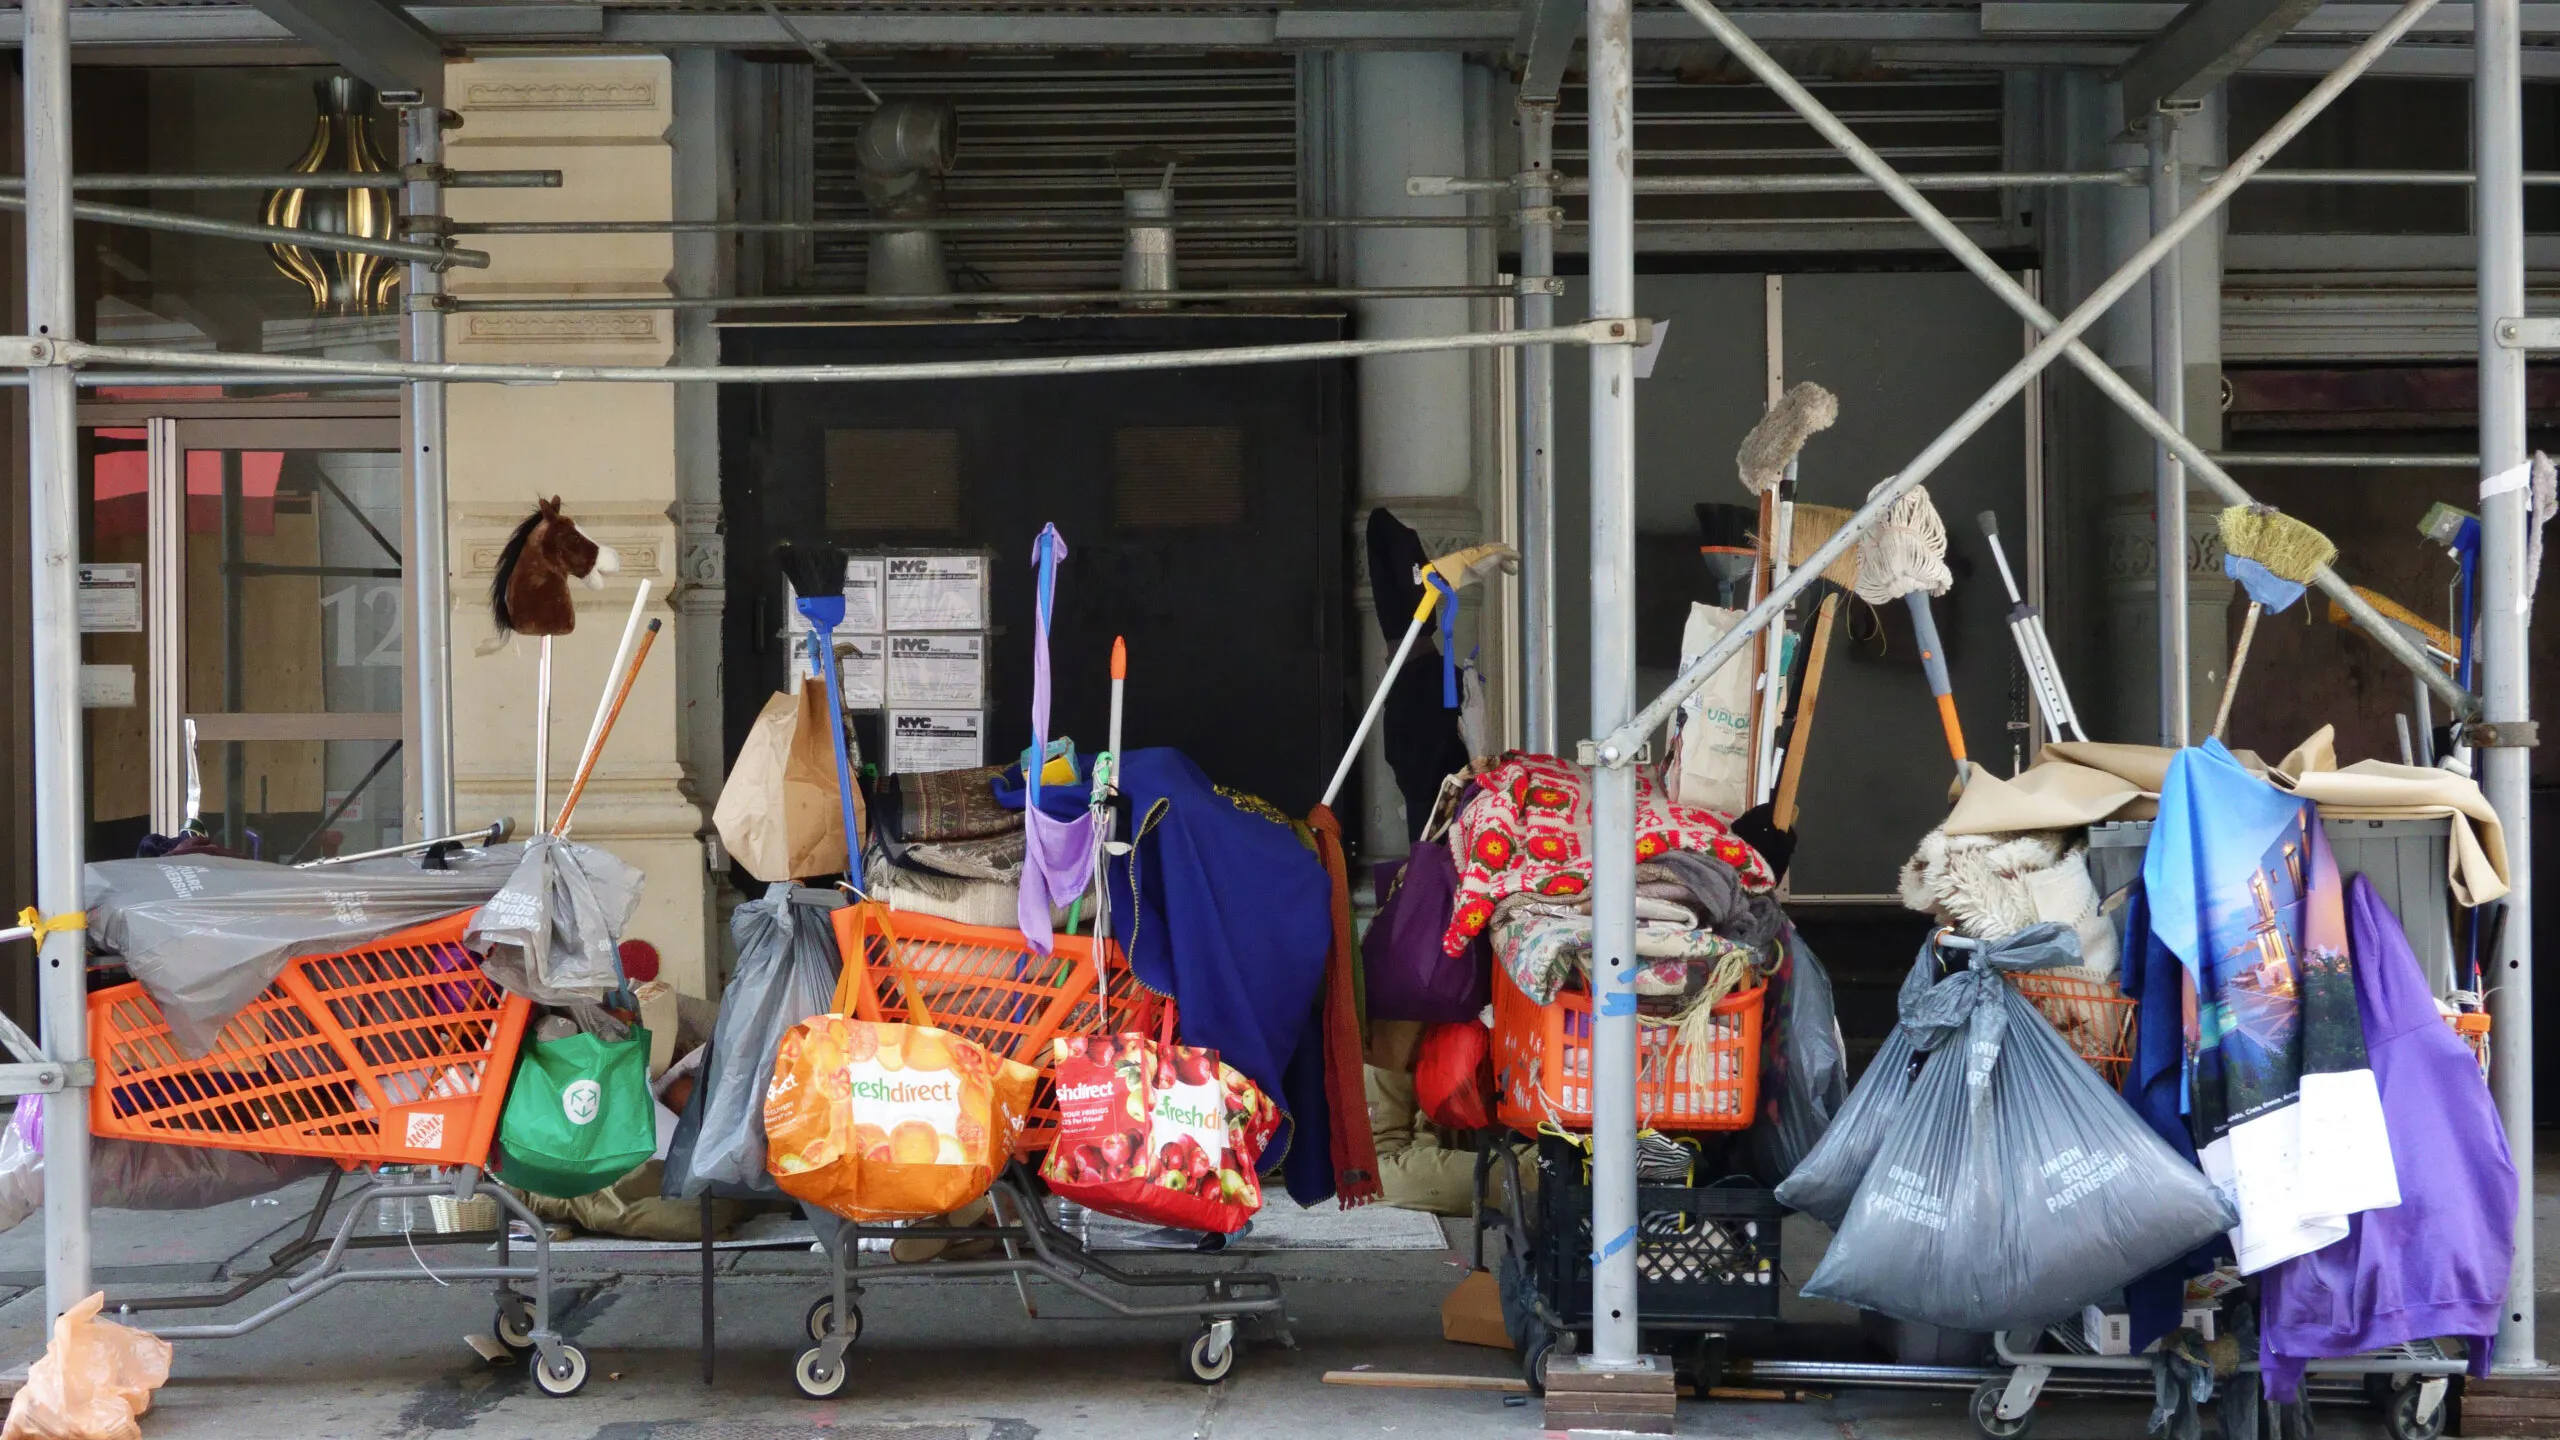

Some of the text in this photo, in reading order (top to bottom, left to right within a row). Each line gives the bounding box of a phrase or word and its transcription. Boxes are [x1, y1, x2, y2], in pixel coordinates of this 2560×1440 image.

[890, 560, 928, 573] NYC
[892, 638, 930, 651] NYC
[897, 716, 931, 729] NYC
[487, 899, 537, 916] SQUAR
[851, 1078, 952, 1103] reshdirect
[1056, 1081, 1115, 1101] shdirect
[407, 1115, 442, 1147] HOME
[2040, 1146, 2084, 1178] UNION
[1888, 1164, 1928, 1190] UNION
[1865, 1191, 1946, 1232] PARTNERSHI
